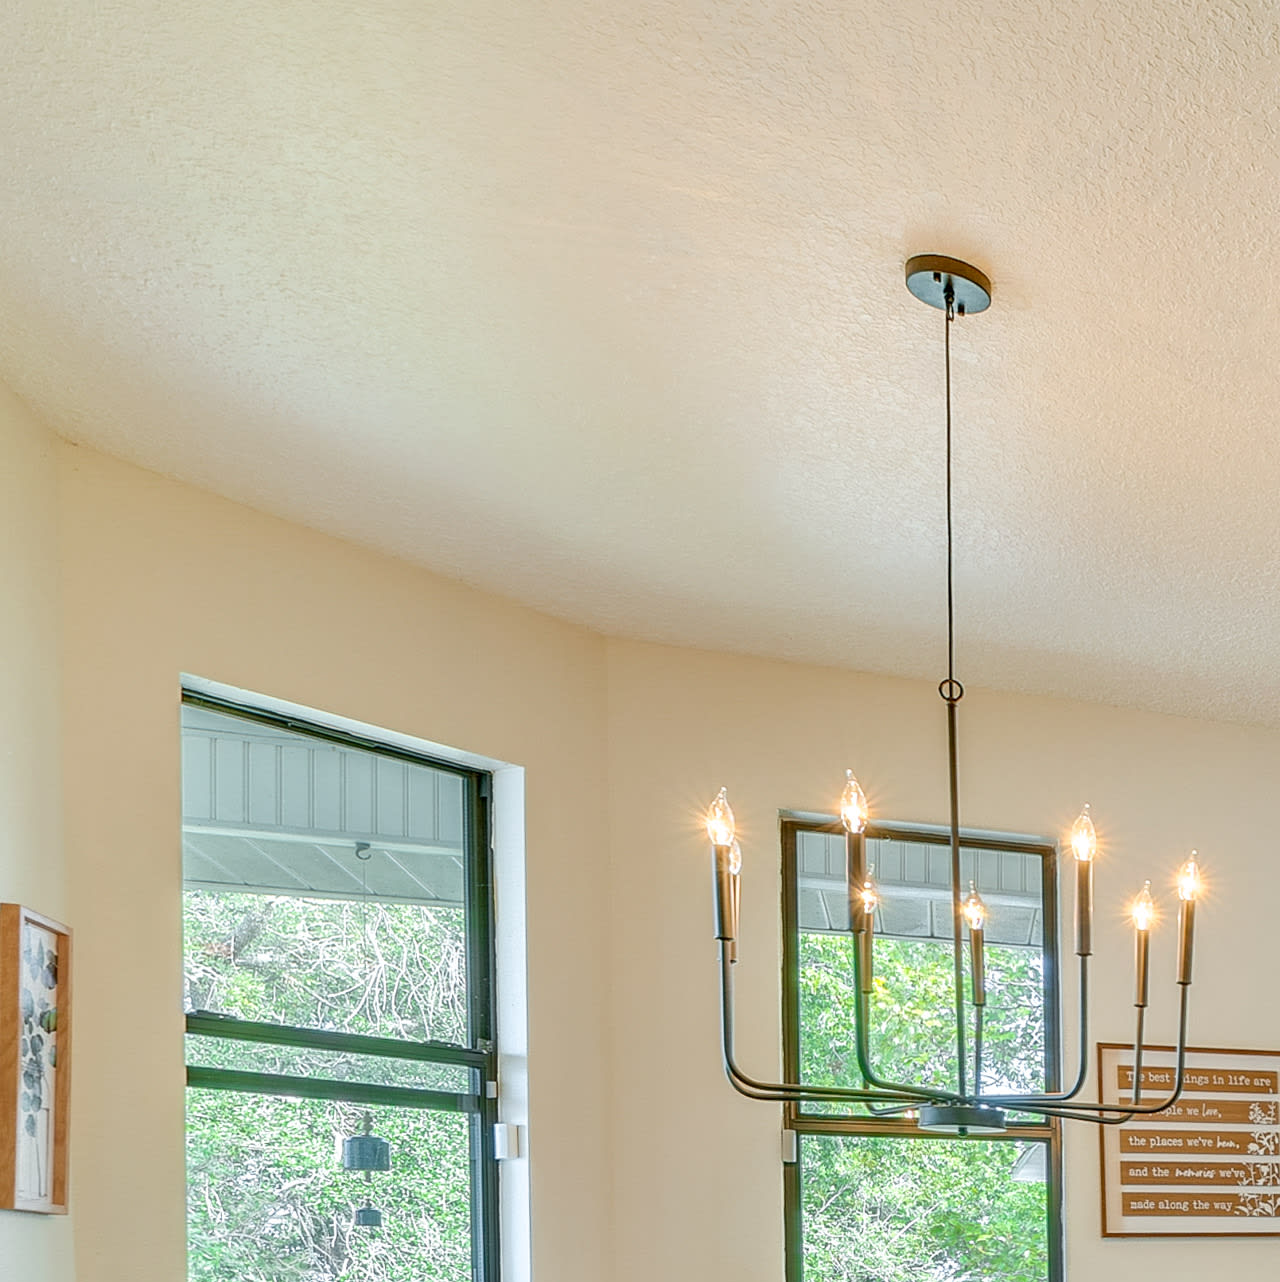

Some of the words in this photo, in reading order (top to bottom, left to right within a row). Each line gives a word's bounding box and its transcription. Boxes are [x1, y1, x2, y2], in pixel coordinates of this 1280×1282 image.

[1126, 1071, 1145, 1082] Te
[1148, 1072, 1171, 1083] best
[1173, 1073, 1209, 1086] ings
[1212, 1074, 1225, 1085] in
[1228, 1074, 1251, 1086] life
[1253, 1077, 1271, 1087] are
[1186, 1106, 1200, 1116] we
[1128, 1136, 1147, 1146] the
[1149, 1136, 1183, 1149] places
[1186, 1137, 1214, 1147] we've
[1128, 1167, 1148, 1177] and
[1151, 1167, 1169, 1177] the
[1219, 1168, 1246, 1178] we've
[1130, 1200, 1155, 1210] made
[1158, 1200, 1189, 1211] along
[1192, 1200, 1210, 1210] the
[1213, 1201, 1232, 1211] way
